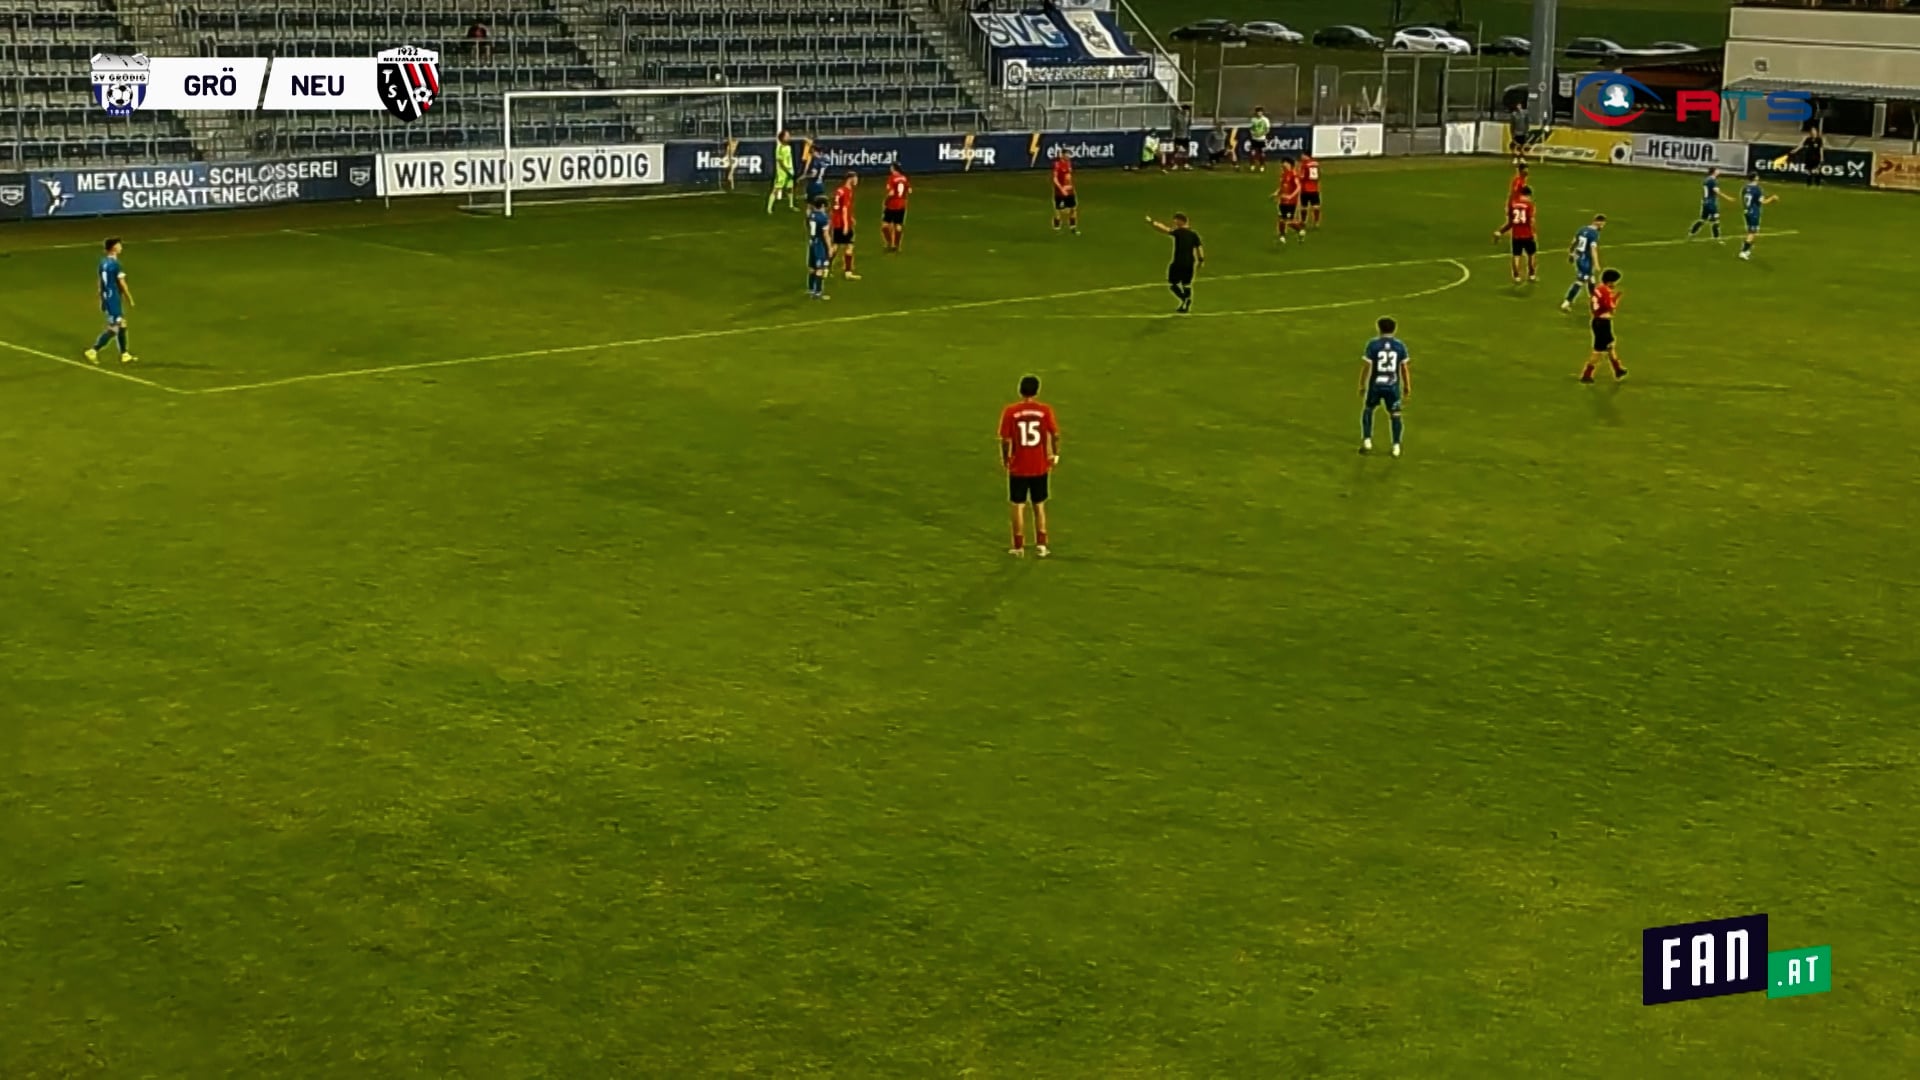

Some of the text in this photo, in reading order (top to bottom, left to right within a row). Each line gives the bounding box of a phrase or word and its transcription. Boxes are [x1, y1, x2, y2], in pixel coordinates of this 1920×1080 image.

[1047, 141, 1115, 159] ehscher.at
[77, 169, 194, 192] METALLBAU
[209, 160, 338, 185] SCHLOSSEREI
[395, 161, 446, 188] WIR
[454, 158, 514, 187] SIND
[522, 157, 552, 182] SV
[560, 149, 649, 180] GRÖDIG
[122, 181, 300, 209] SCHRATTENECKER
[1512, 209, 1527, 224] 24
[1377, 351, 1398, 372] 23
[1017, 421, 1041, 446] 15
